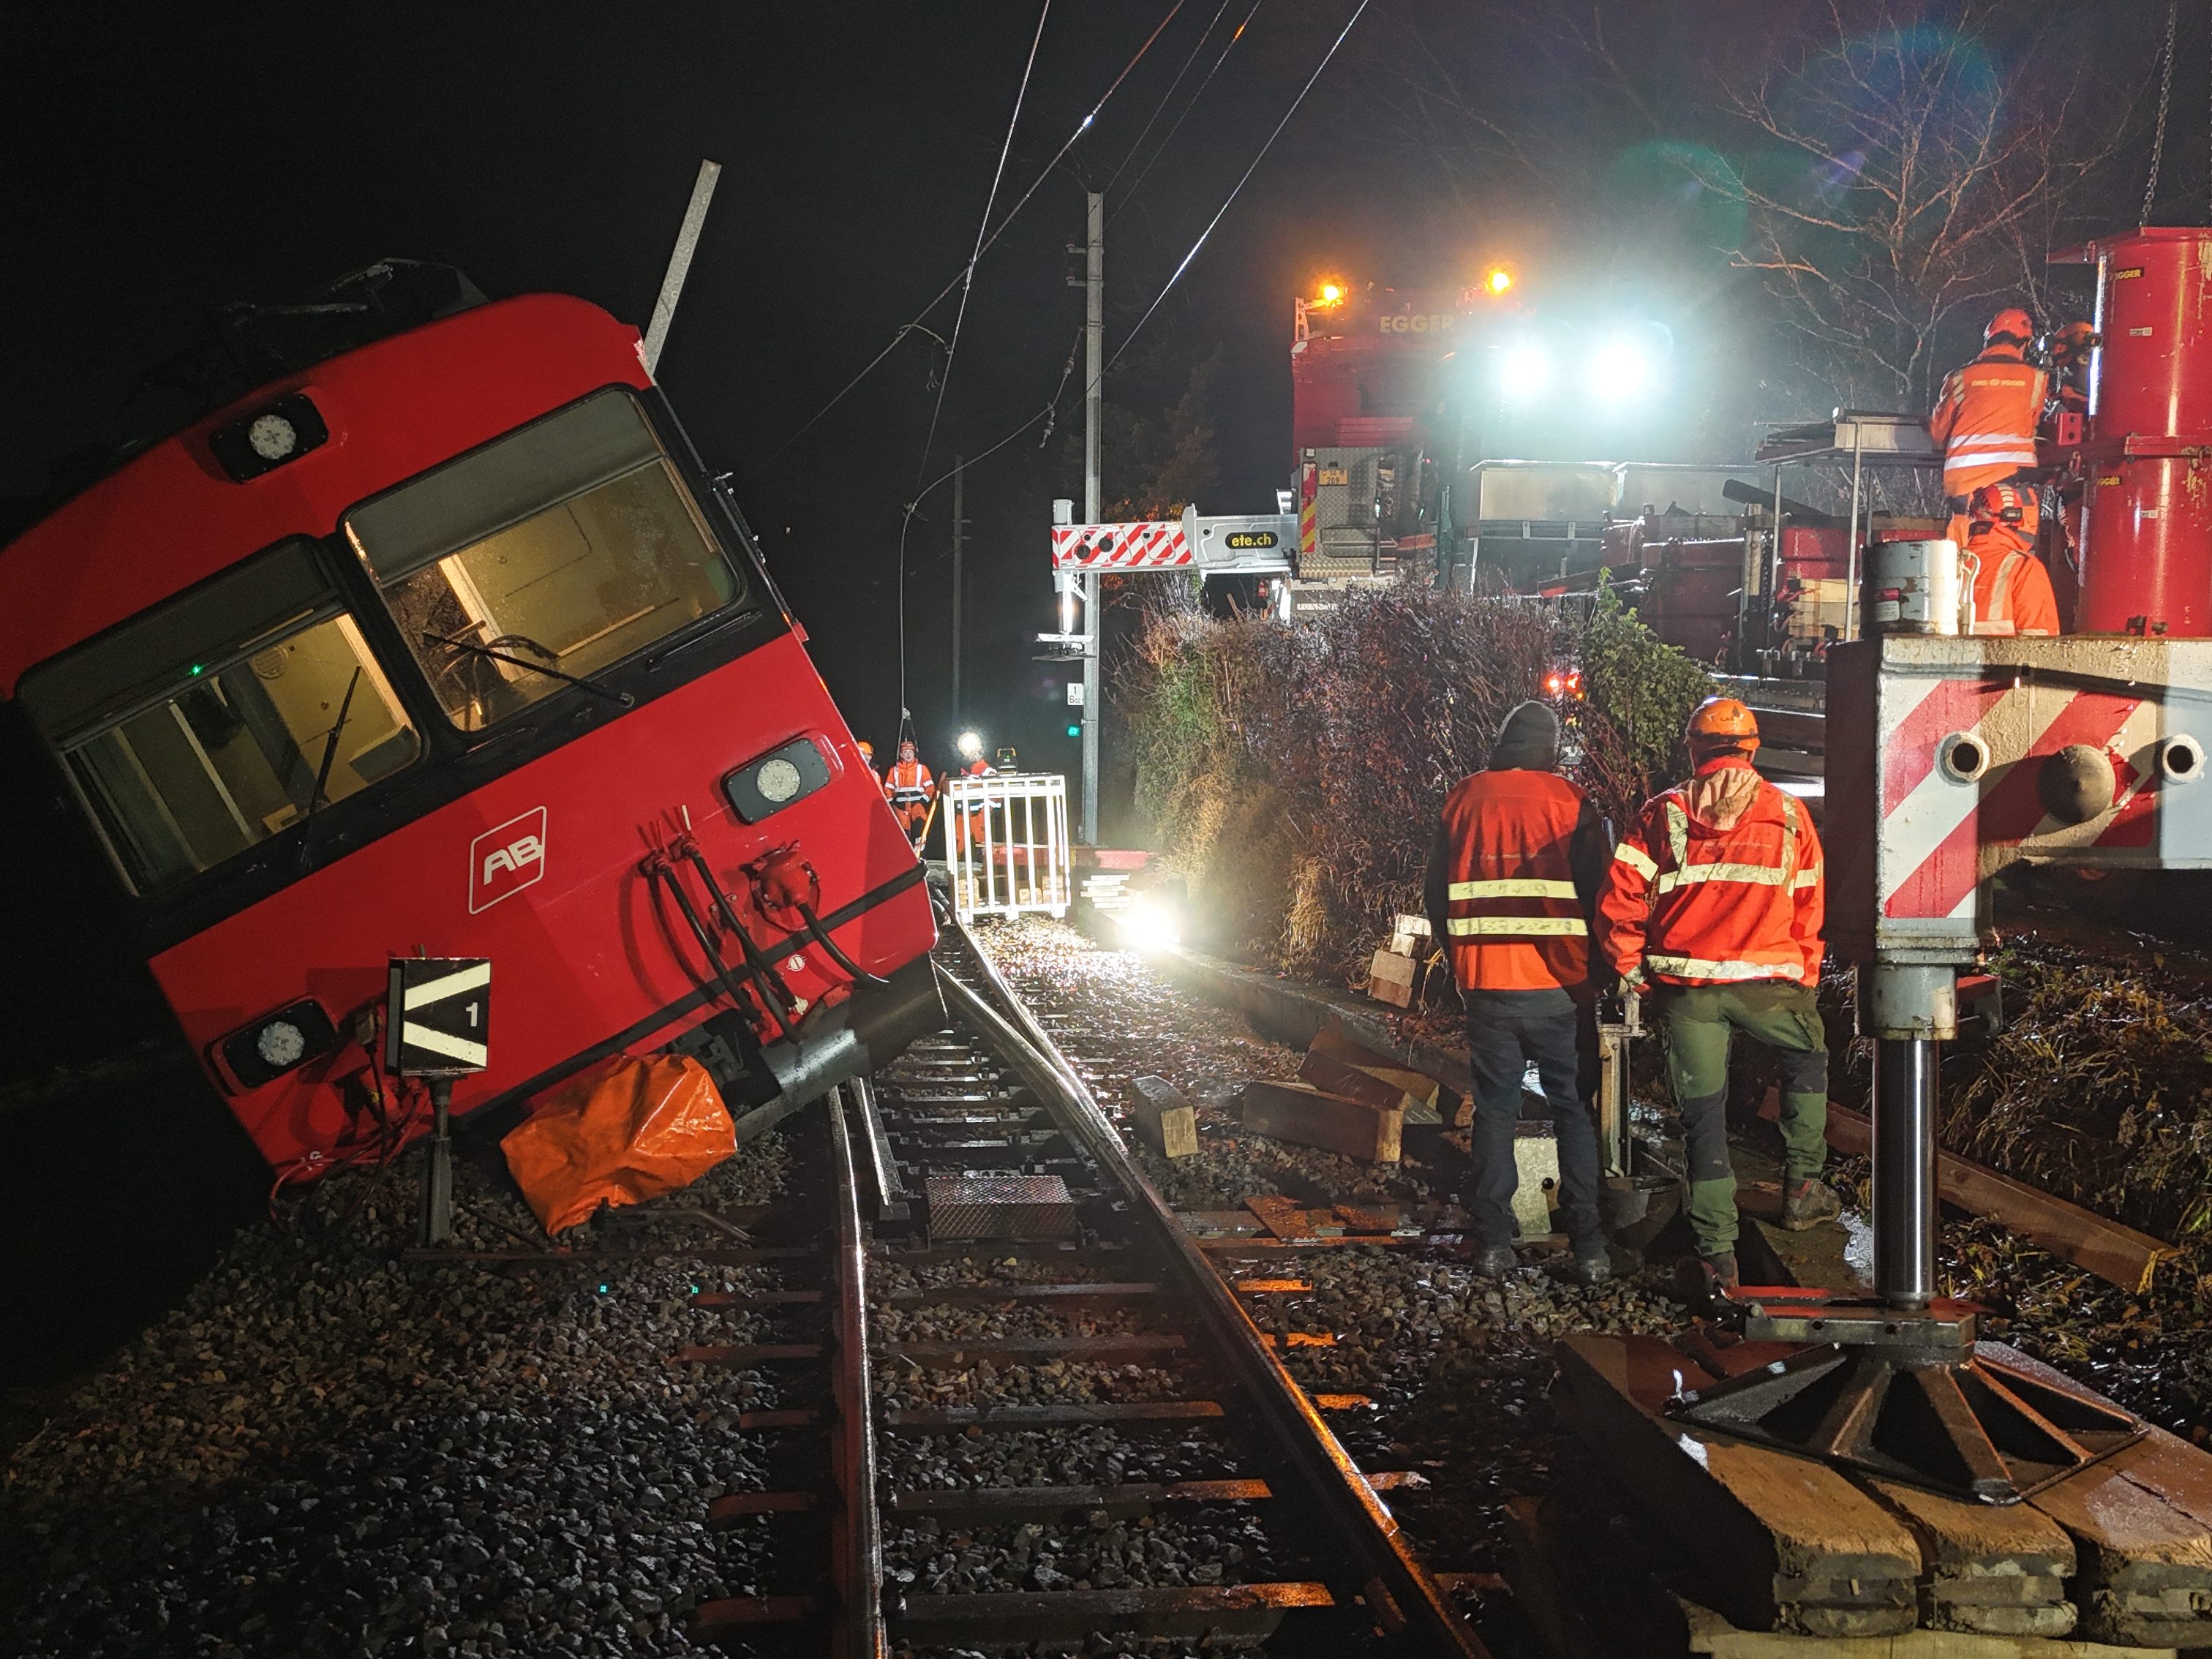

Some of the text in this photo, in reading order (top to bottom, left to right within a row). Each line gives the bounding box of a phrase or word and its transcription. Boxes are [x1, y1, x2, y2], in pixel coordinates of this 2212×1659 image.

[1380, 315, 1454, 334] EGGER
[1231, 533, 1272, 547] ete.ch
[483, 835, 543, 886] AB
[465, 1001, 478, 1027] 1
